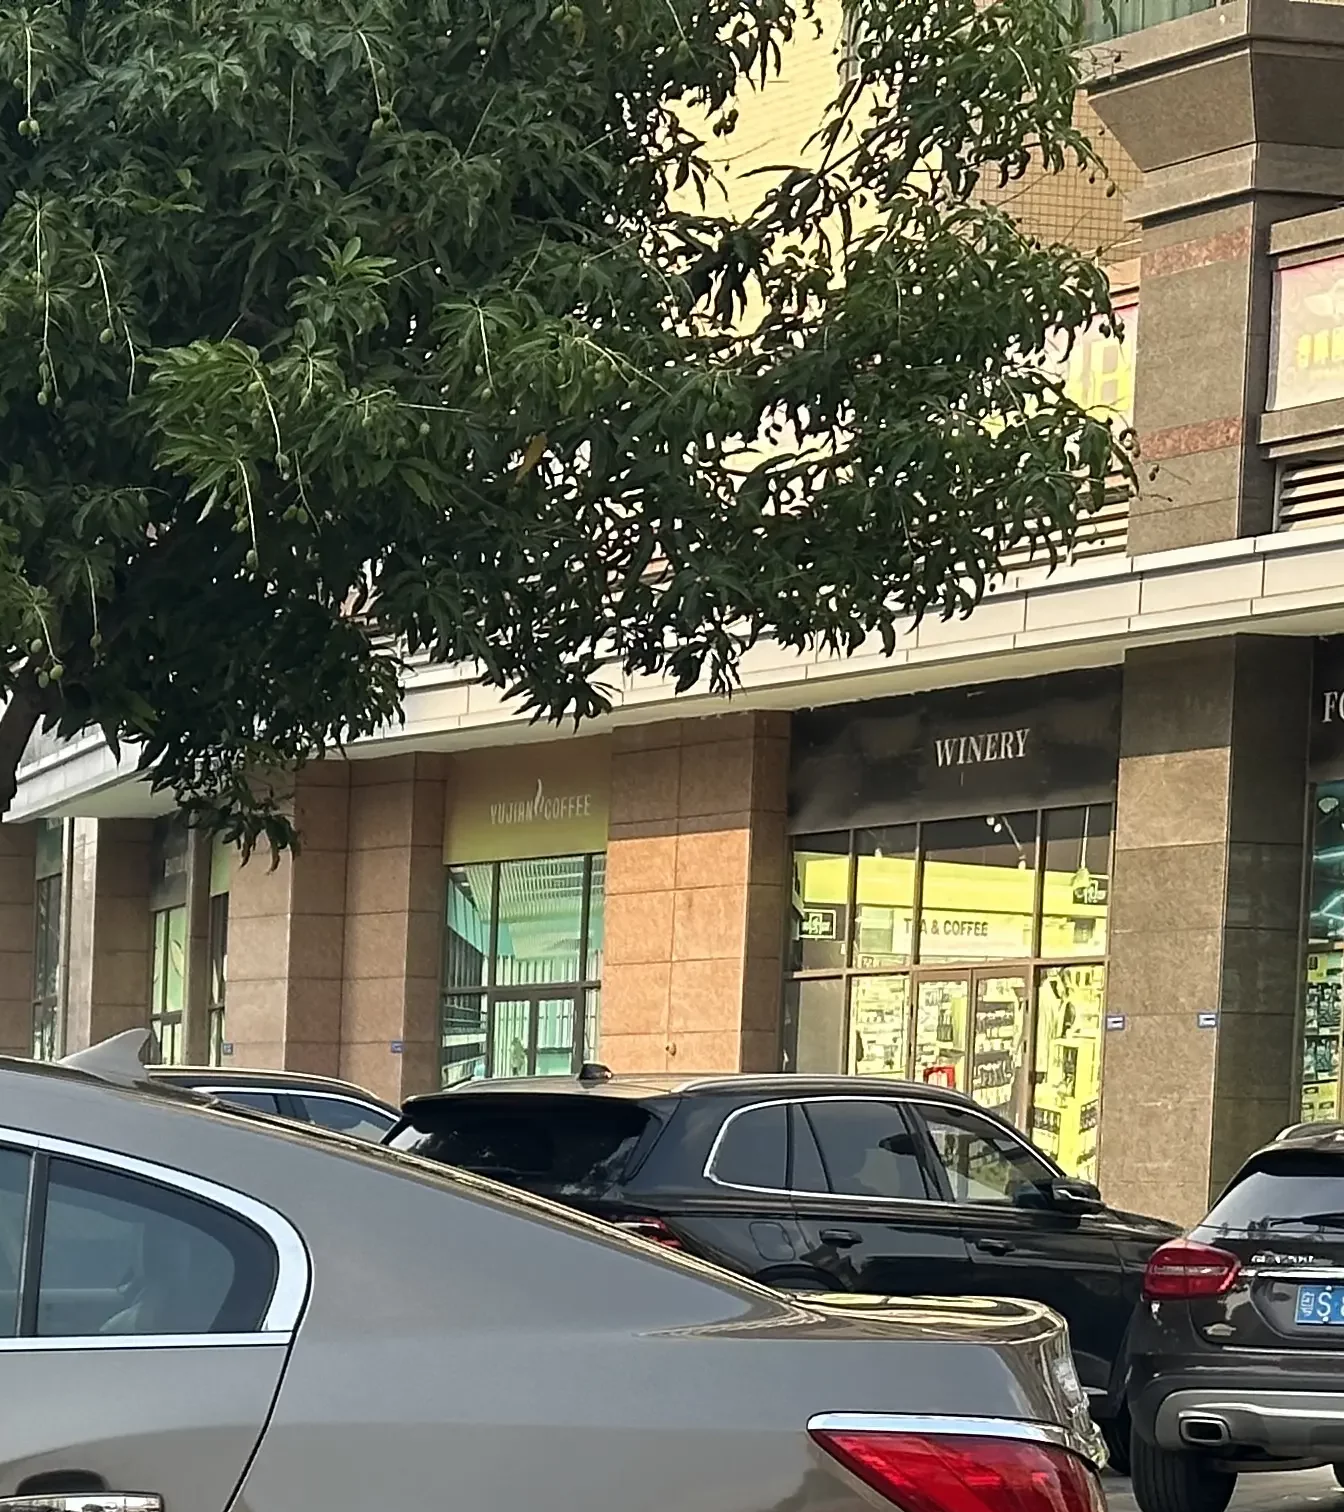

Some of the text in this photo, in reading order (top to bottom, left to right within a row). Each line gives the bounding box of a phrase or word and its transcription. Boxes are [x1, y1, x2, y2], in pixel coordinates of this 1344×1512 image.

[935, 727, 1031, 768] WINERY
[490, 793, 592, 825] YUJIAN COFFEE
[903, 917, 989, 937] TA & COFFEE
